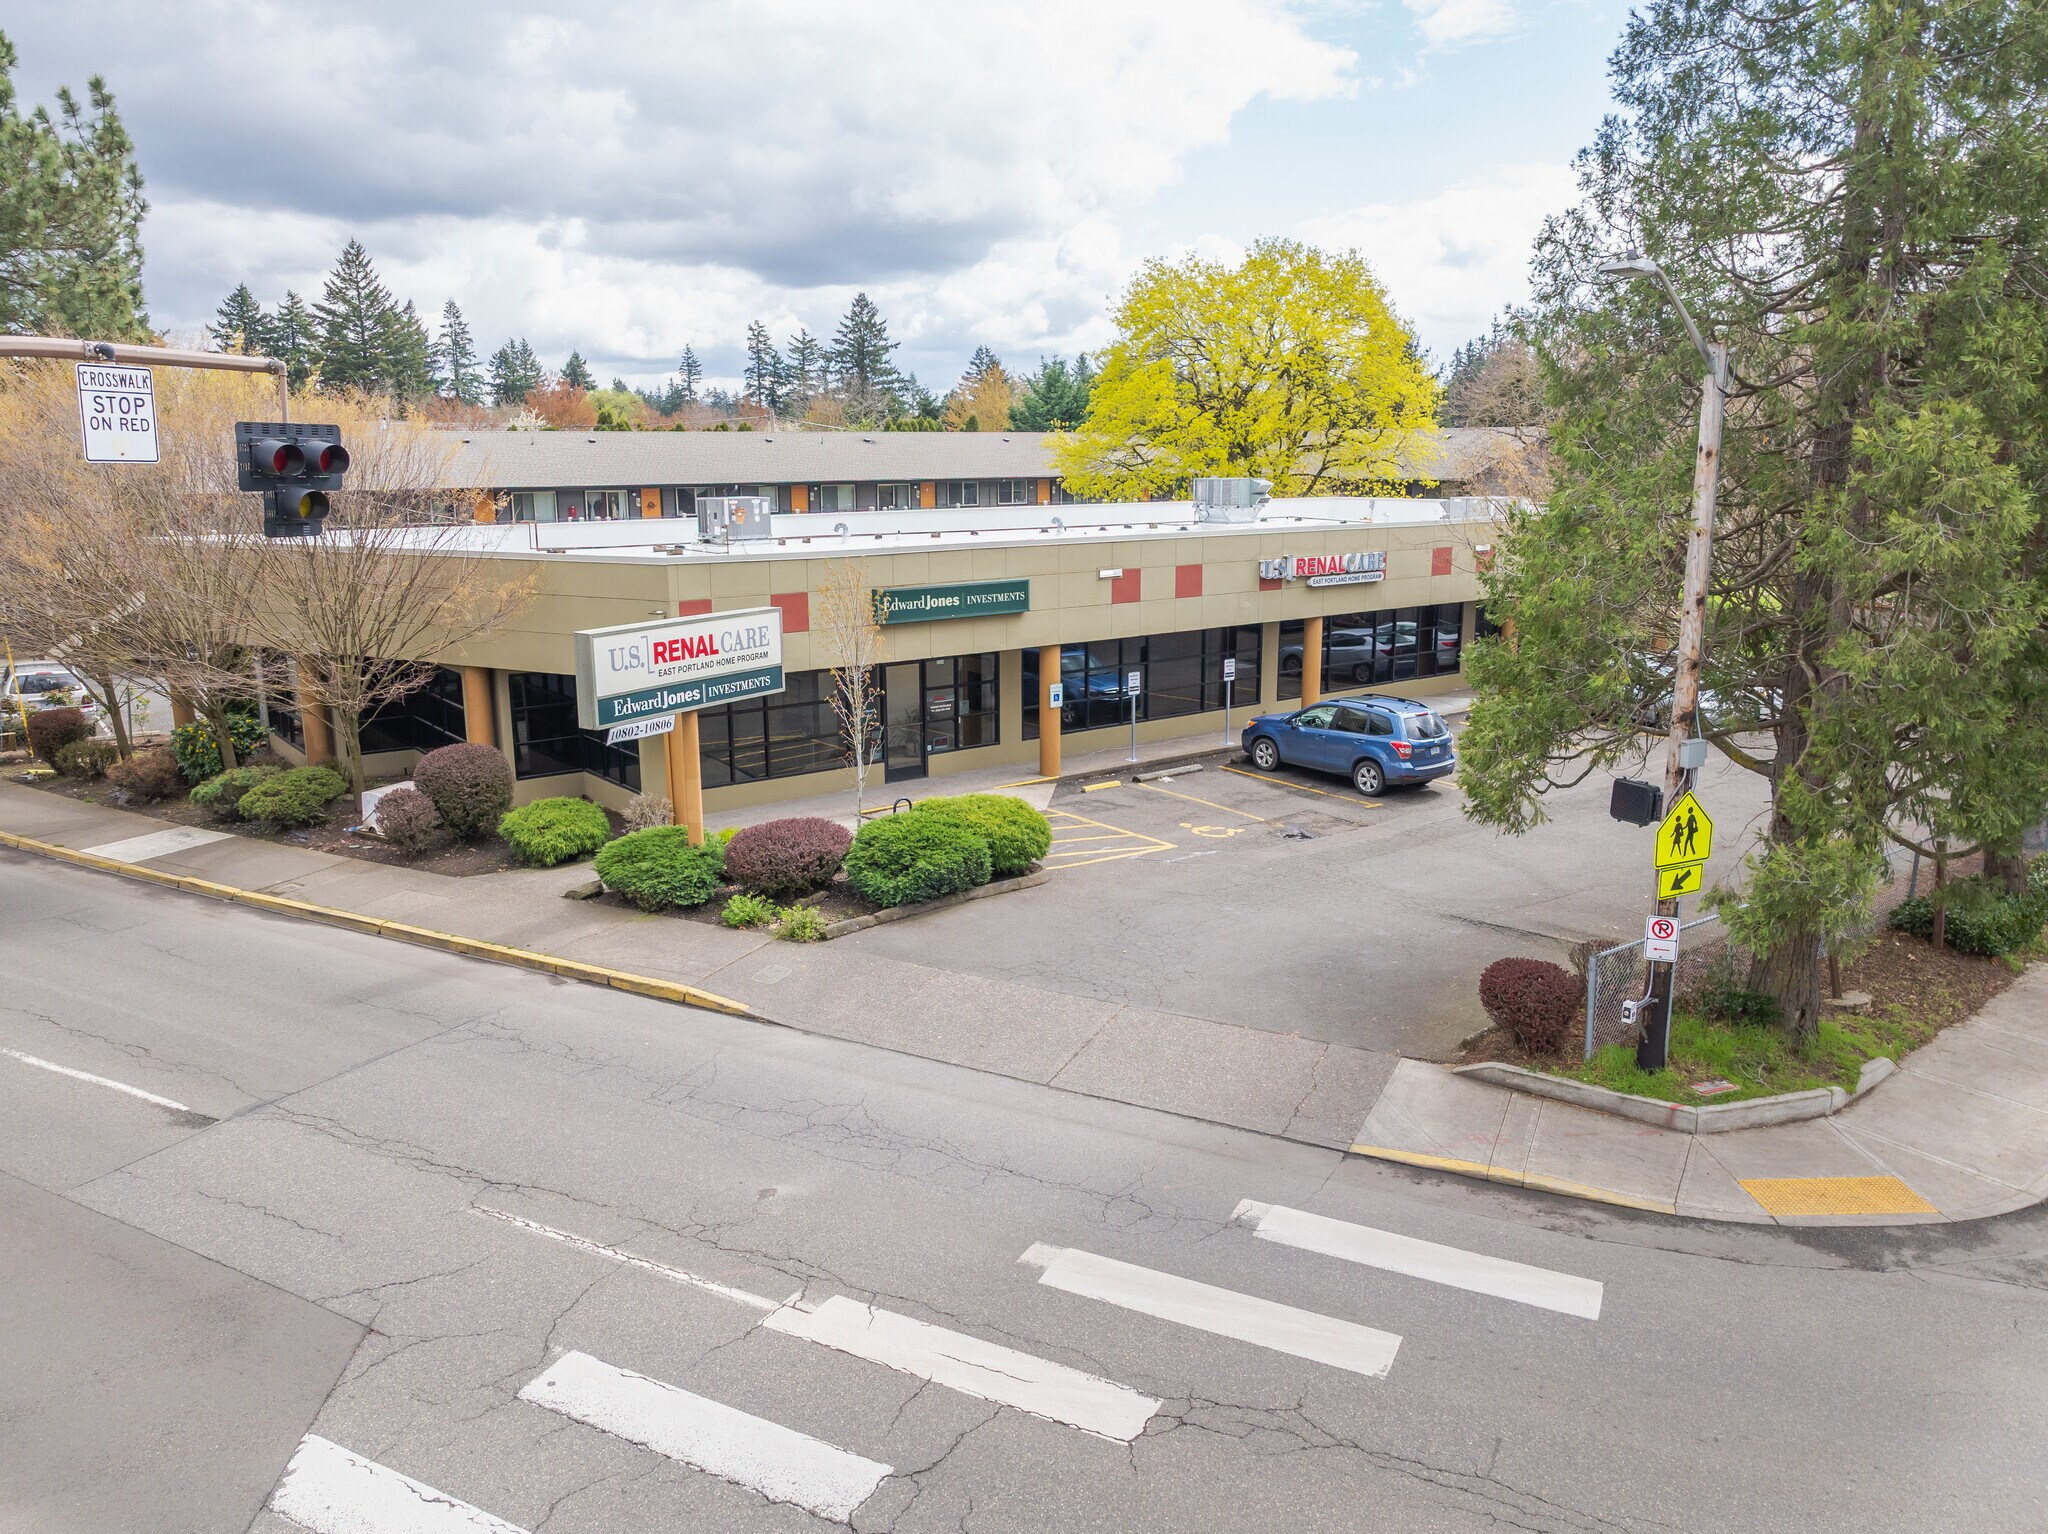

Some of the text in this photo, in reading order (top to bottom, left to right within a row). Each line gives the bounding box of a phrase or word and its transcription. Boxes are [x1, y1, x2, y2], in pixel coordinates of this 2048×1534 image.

[80, 371, 150, 390] CROSSWALK
[94, 396, 145, 415] STOP
[90, 416, 150, 432] ON RED
[1295, 556, 1346, 577] RENAL
[1346, 552, 1386, 572] CARE
[1324, 576, 1347, 584] PORTLAND
[1361, 573, 1382, 581] PROGRAM
[967, 591, 1025, 605] INVESTMENTS
[652, 634, 720, 665] RENAL
[720, 625, 770, 653] CARE
[658, 651, 769, 677] EAST PORTLAND HOME PROGRAM
[708, 675, 771, 698] INVESTMENTS
[610, 719, 673, 742] 10802-10806
